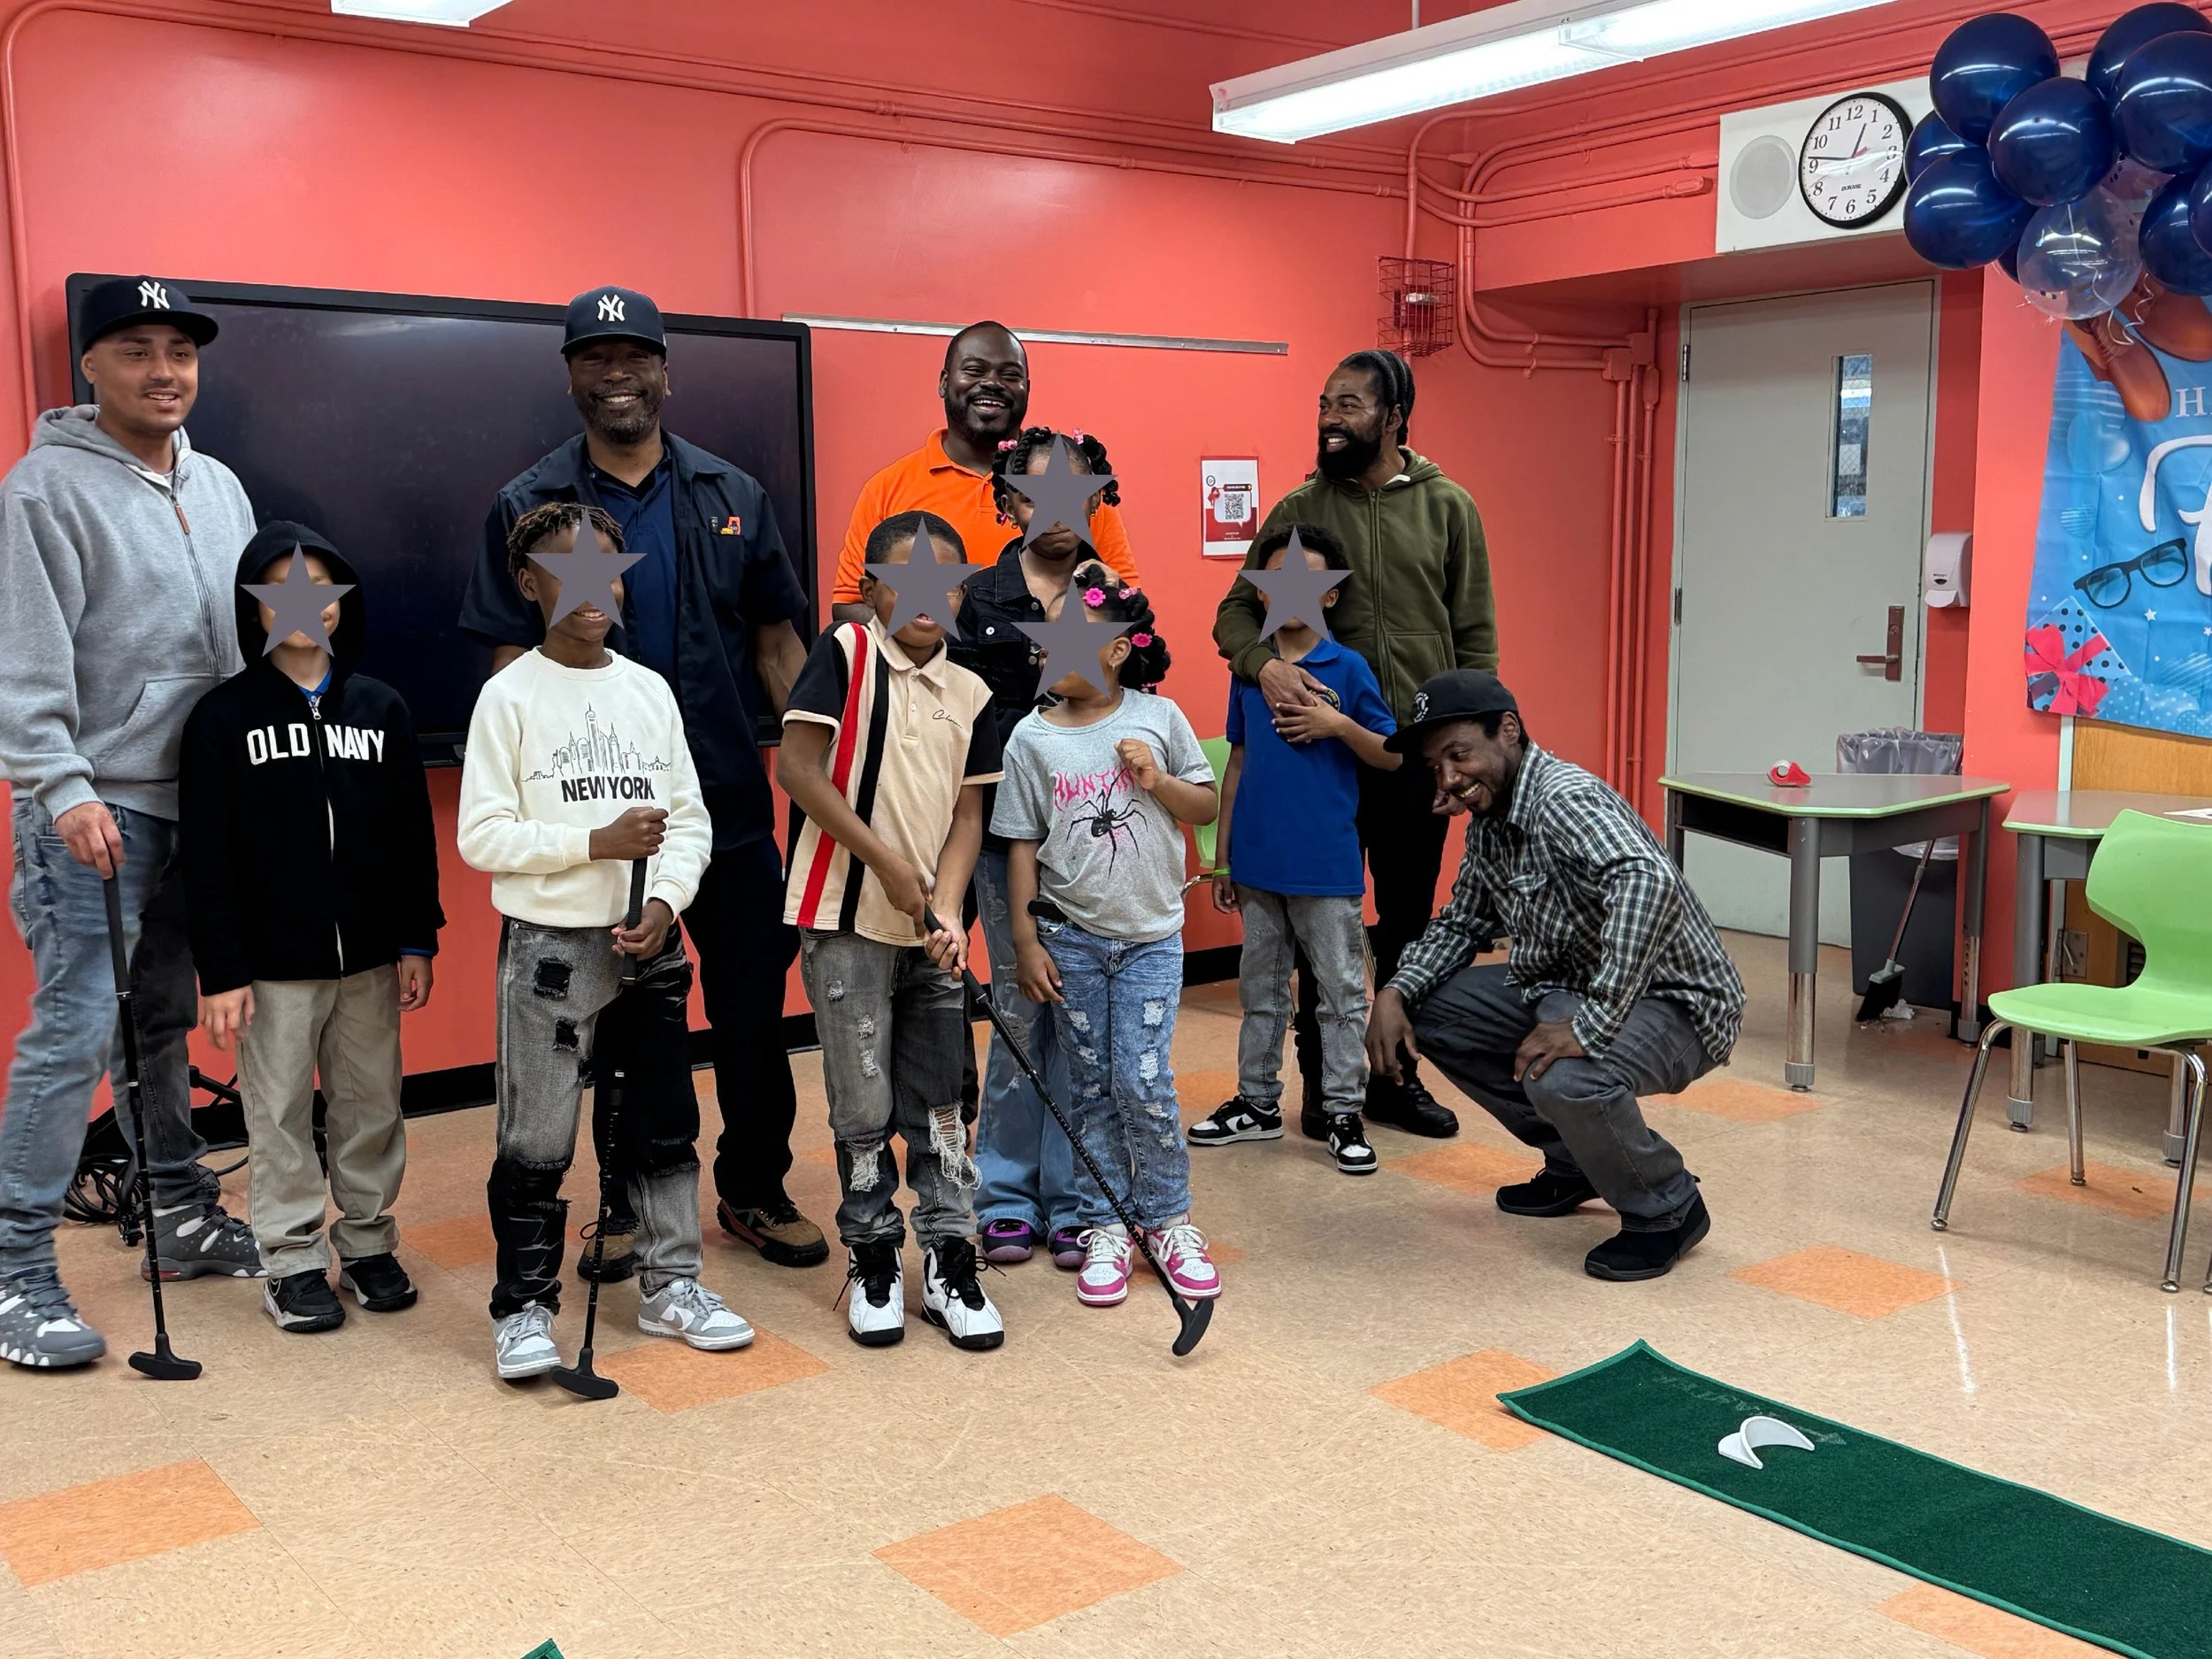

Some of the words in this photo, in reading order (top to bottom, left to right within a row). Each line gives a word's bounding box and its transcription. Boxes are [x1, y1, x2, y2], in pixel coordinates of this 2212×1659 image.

[1845, 105, 1863, 121] 12
[1870, 109, 1878, 123] 1
[1828, 116, 1841, 131] 11
[1881, 124, 1893, 140] 2
[1812, 134, 1828, 150] 10
[1886, 145, 1897, 160] 3
[1809, 159, 1818, 173] 9
[1879, 168, 1889, 183] 4
[1813, 180, 1824, 196] 8
[1866, 188, 1877, 204] 5
[1828, 196, 1838, 211] 7
[1846, 199, 1855, 214] 6
[137, 280, 171, 310] NY
[597, 294, 626, 322] NY
[2175, 386, 2212, 418] H
[247, 723, 311, 765] OLD
[324, 725, 385, 763] NAVY
[561, 776, 605, 803] NEW
[607, 776, 656, 800] YORK
